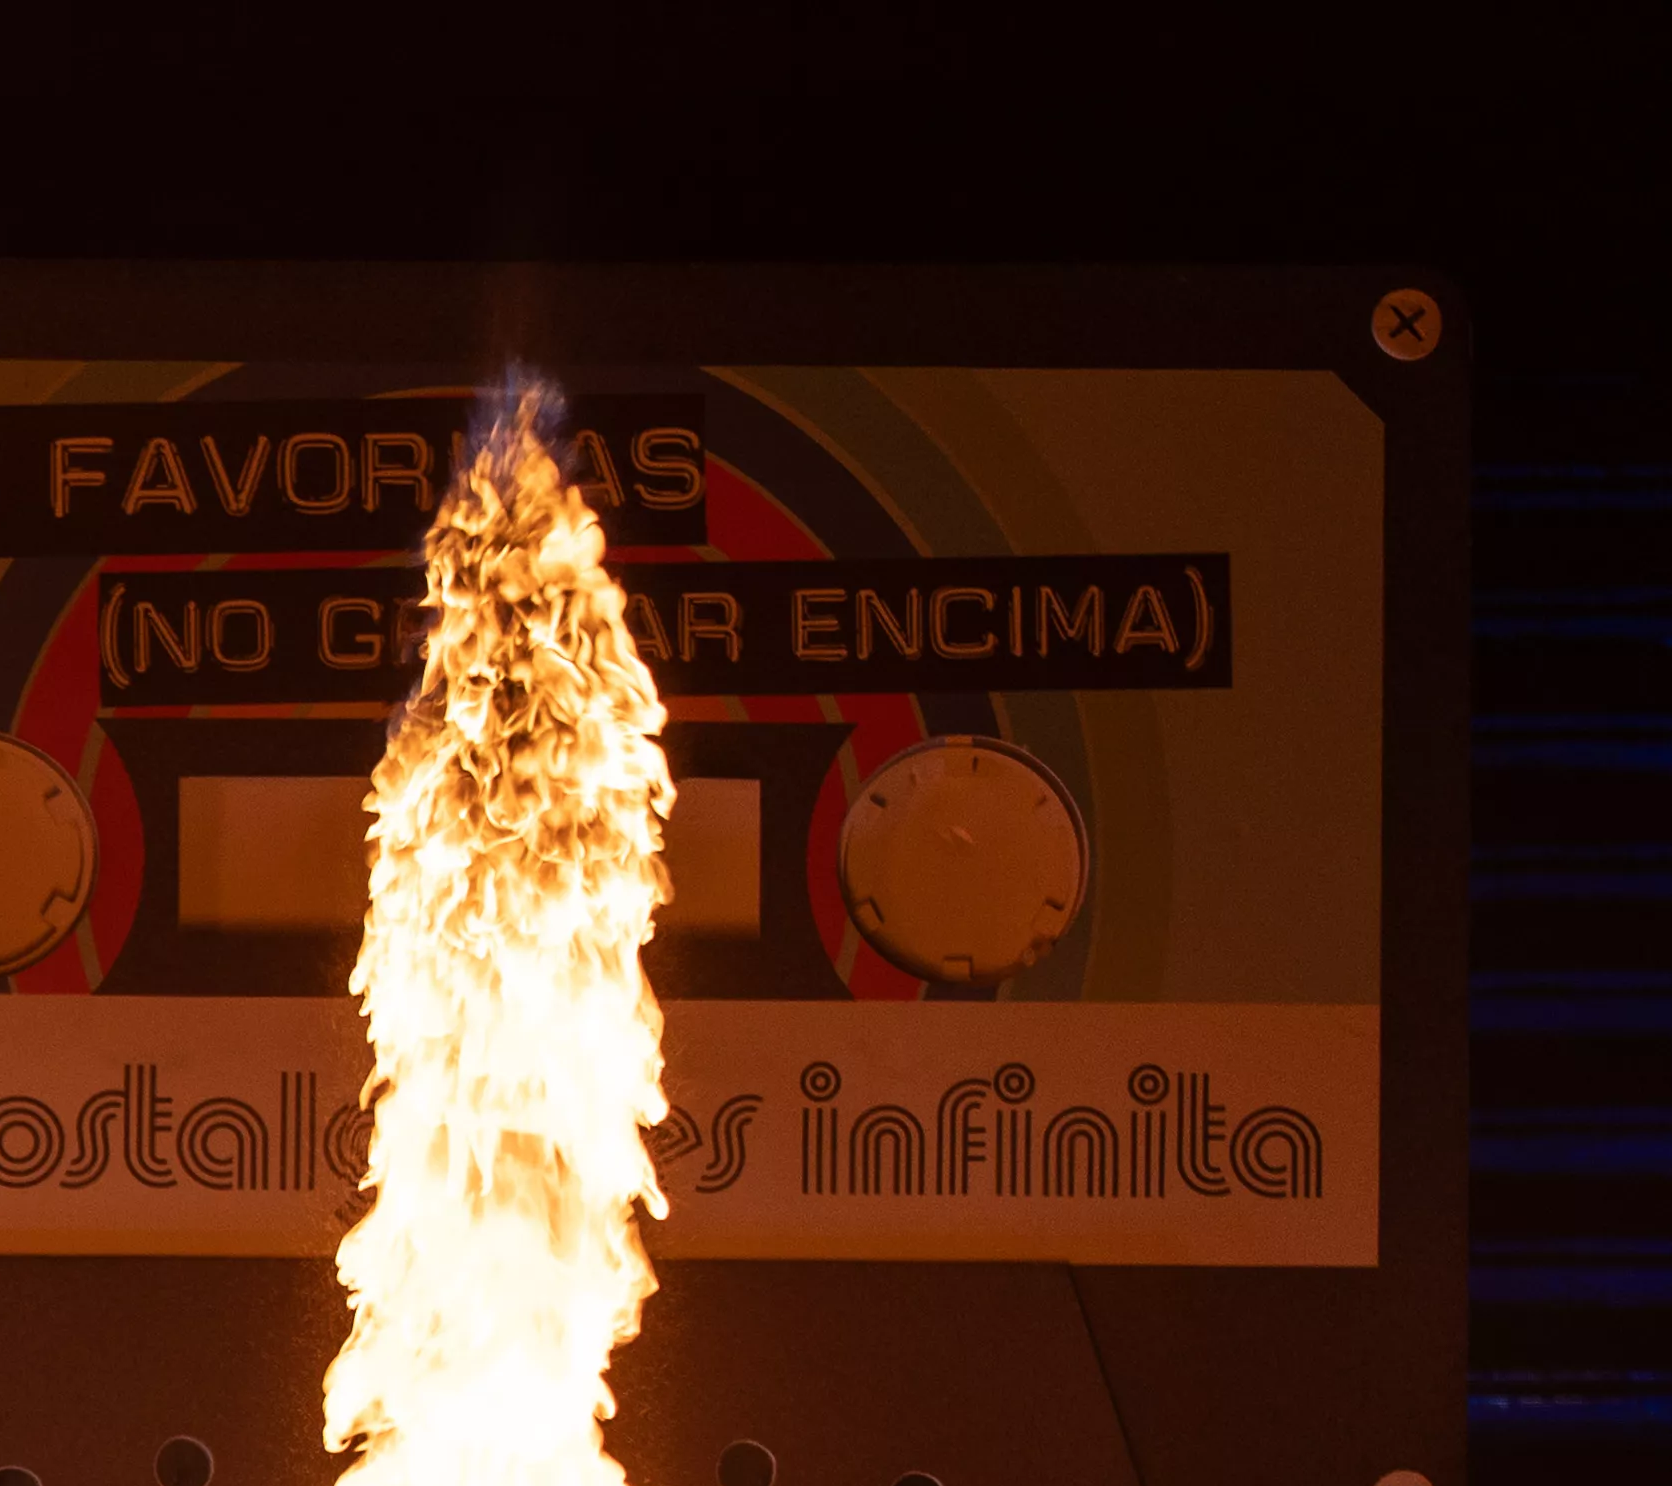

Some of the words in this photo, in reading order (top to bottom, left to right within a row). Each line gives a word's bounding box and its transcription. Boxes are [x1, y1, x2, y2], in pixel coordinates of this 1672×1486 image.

[50, 425, 705, 517] FAVORAS
[102, 586, 274, 690] (NO
[317, 592, 746, 670] GAR
[792, 566, 1211, 672] ENCIMA)
[800, 1060, 1324, 1200] infinita
